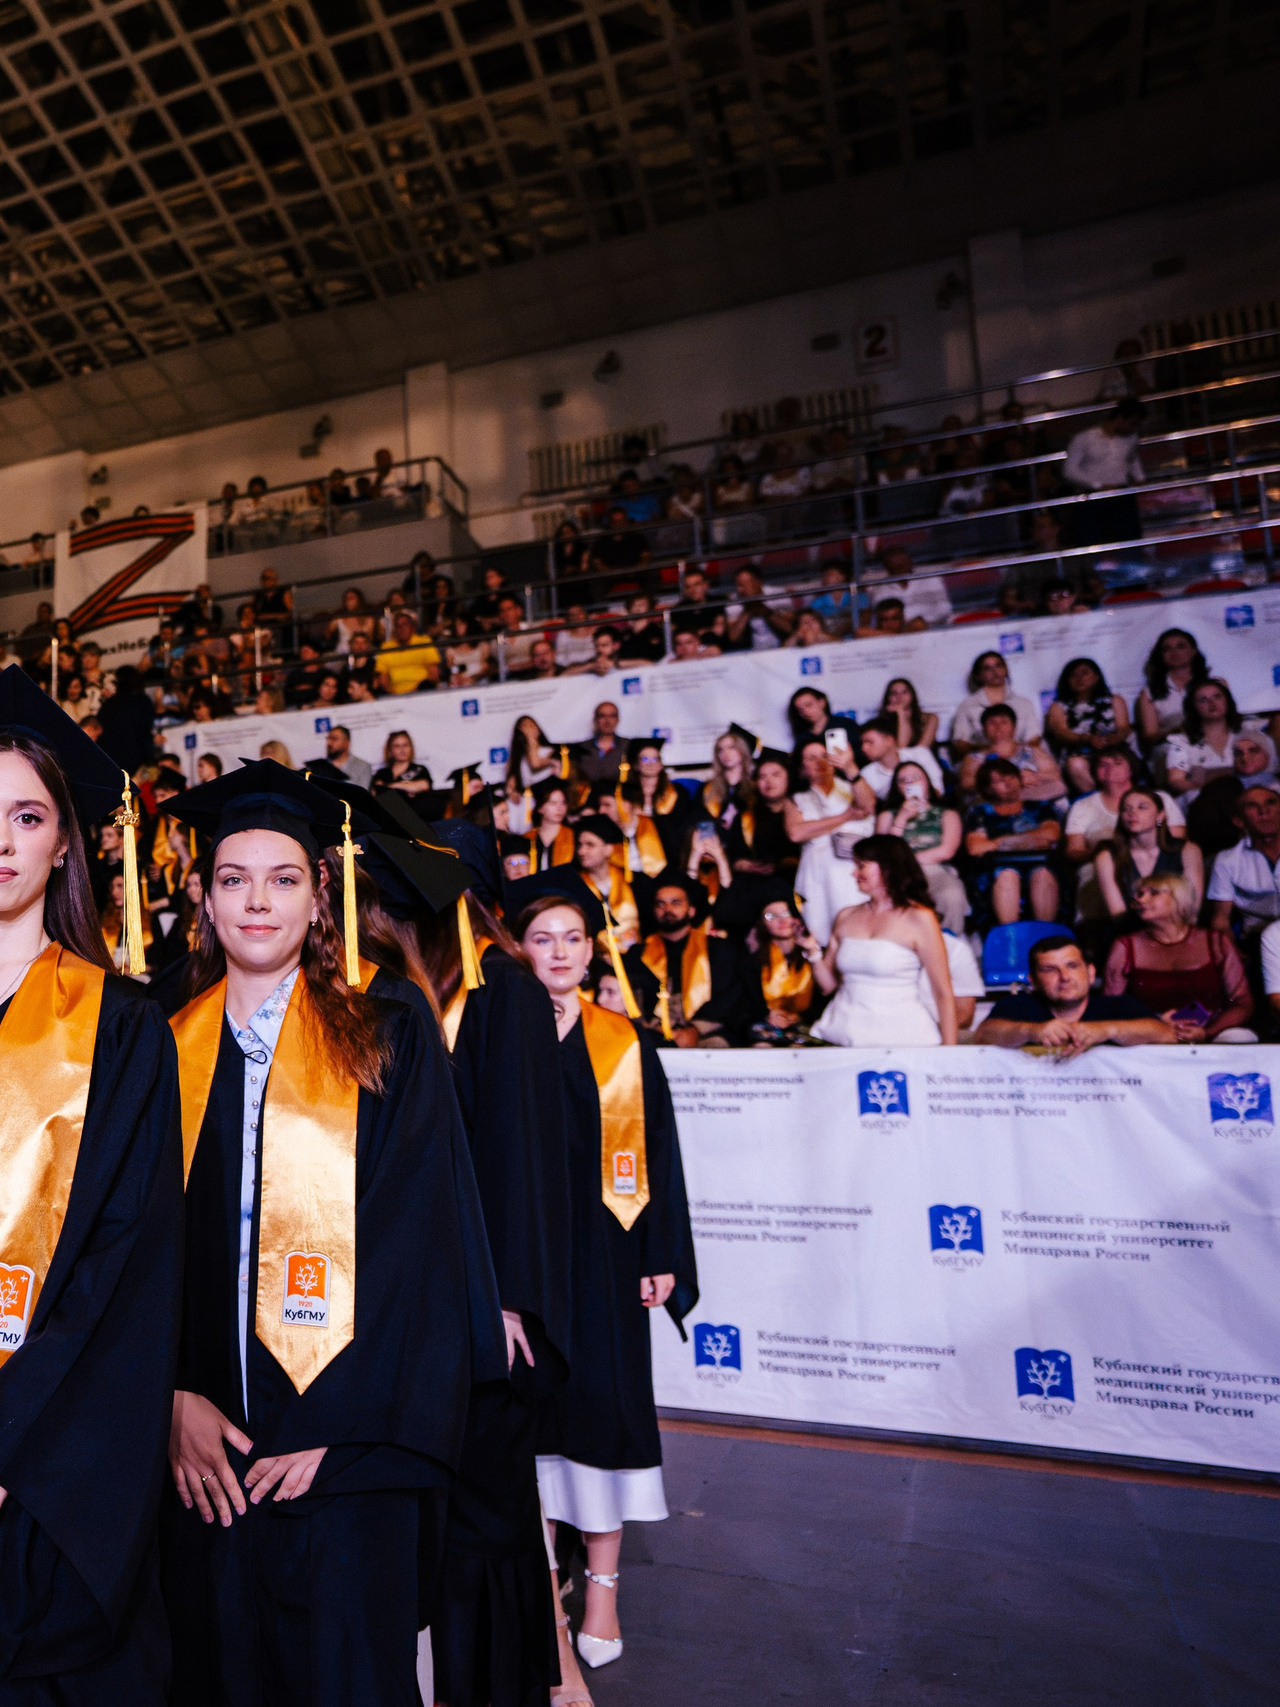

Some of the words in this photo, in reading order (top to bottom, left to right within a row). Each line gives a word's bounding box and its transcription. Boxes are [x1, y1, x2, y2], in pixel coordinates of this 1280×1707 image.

[863, 324, 887, 359] 2
[70, 513, 195, 637] Z
[1001, 1210, 1085, 1226] Кубанский
[1089, 1216, 1231, 1233] государственный
[1111, 1233, 1215, 1249] университет
[1095, 1248, 1151, 1262] России
[285, 1308, 326, 1321] КубГМУ
[298, 1300, 313, 1308] 1920
[1092, 1356, 1182, 1377] Кубанский
[1187, 1367, 1280, 1386] государств
[1094, 1375, 1206, 1396] медицинский
[1211, 1388, 1280, 1405] универс
[1096, 1391, 1188, 1412] Минздрава
[1194, 1400, 1254, 1418] России
